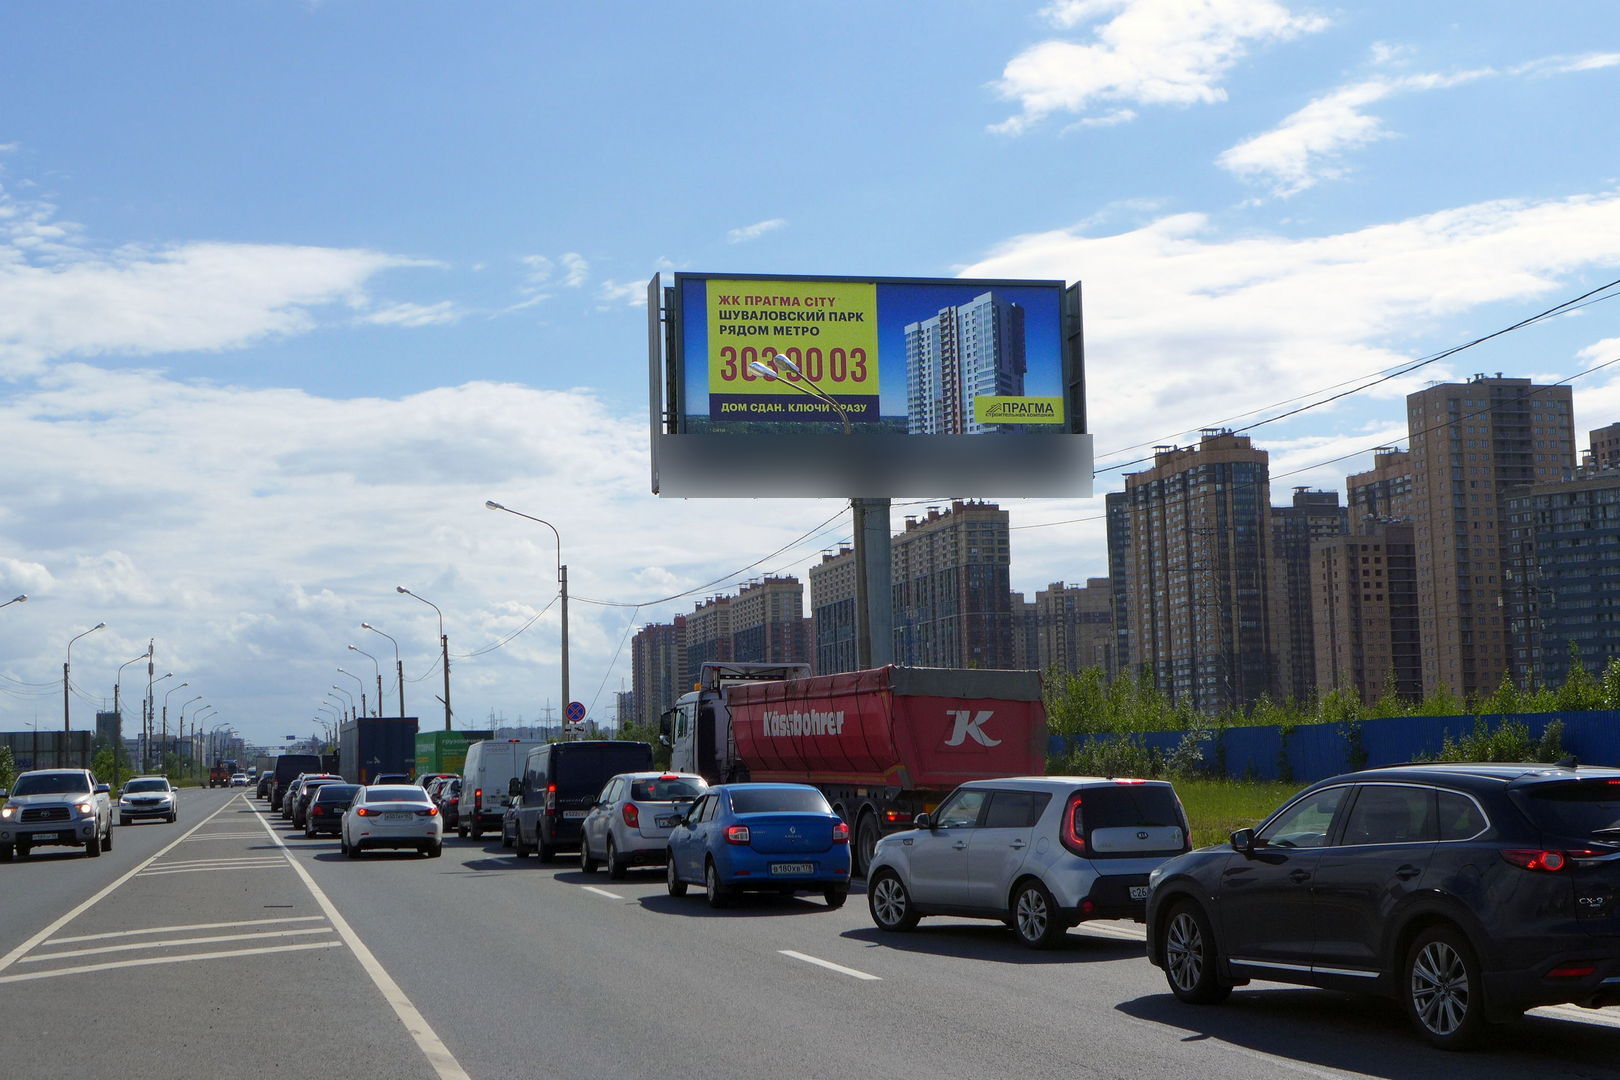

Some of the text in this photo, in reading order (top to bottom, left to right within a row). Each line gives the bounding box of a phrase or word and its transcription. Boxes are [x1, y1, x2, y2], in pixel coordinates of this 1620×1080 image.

[718, 295, 836, 307] ЖК ПРАГМА CITY
[719, 309, 864, 322] ШУВАЛОВСКИЙ ПАРК
[719, 325, 820, 337] РЯДОМ МЕТРО
[721, 402, 748, 413] ДОМ
[750, 403, 786, 413] СДАН.
[788, 403, 830, 413] КЛЮЧИ
[1002, 402, 1054, 414] ПРАГМА
[763, 709, 844, 737] Kässbohrer
